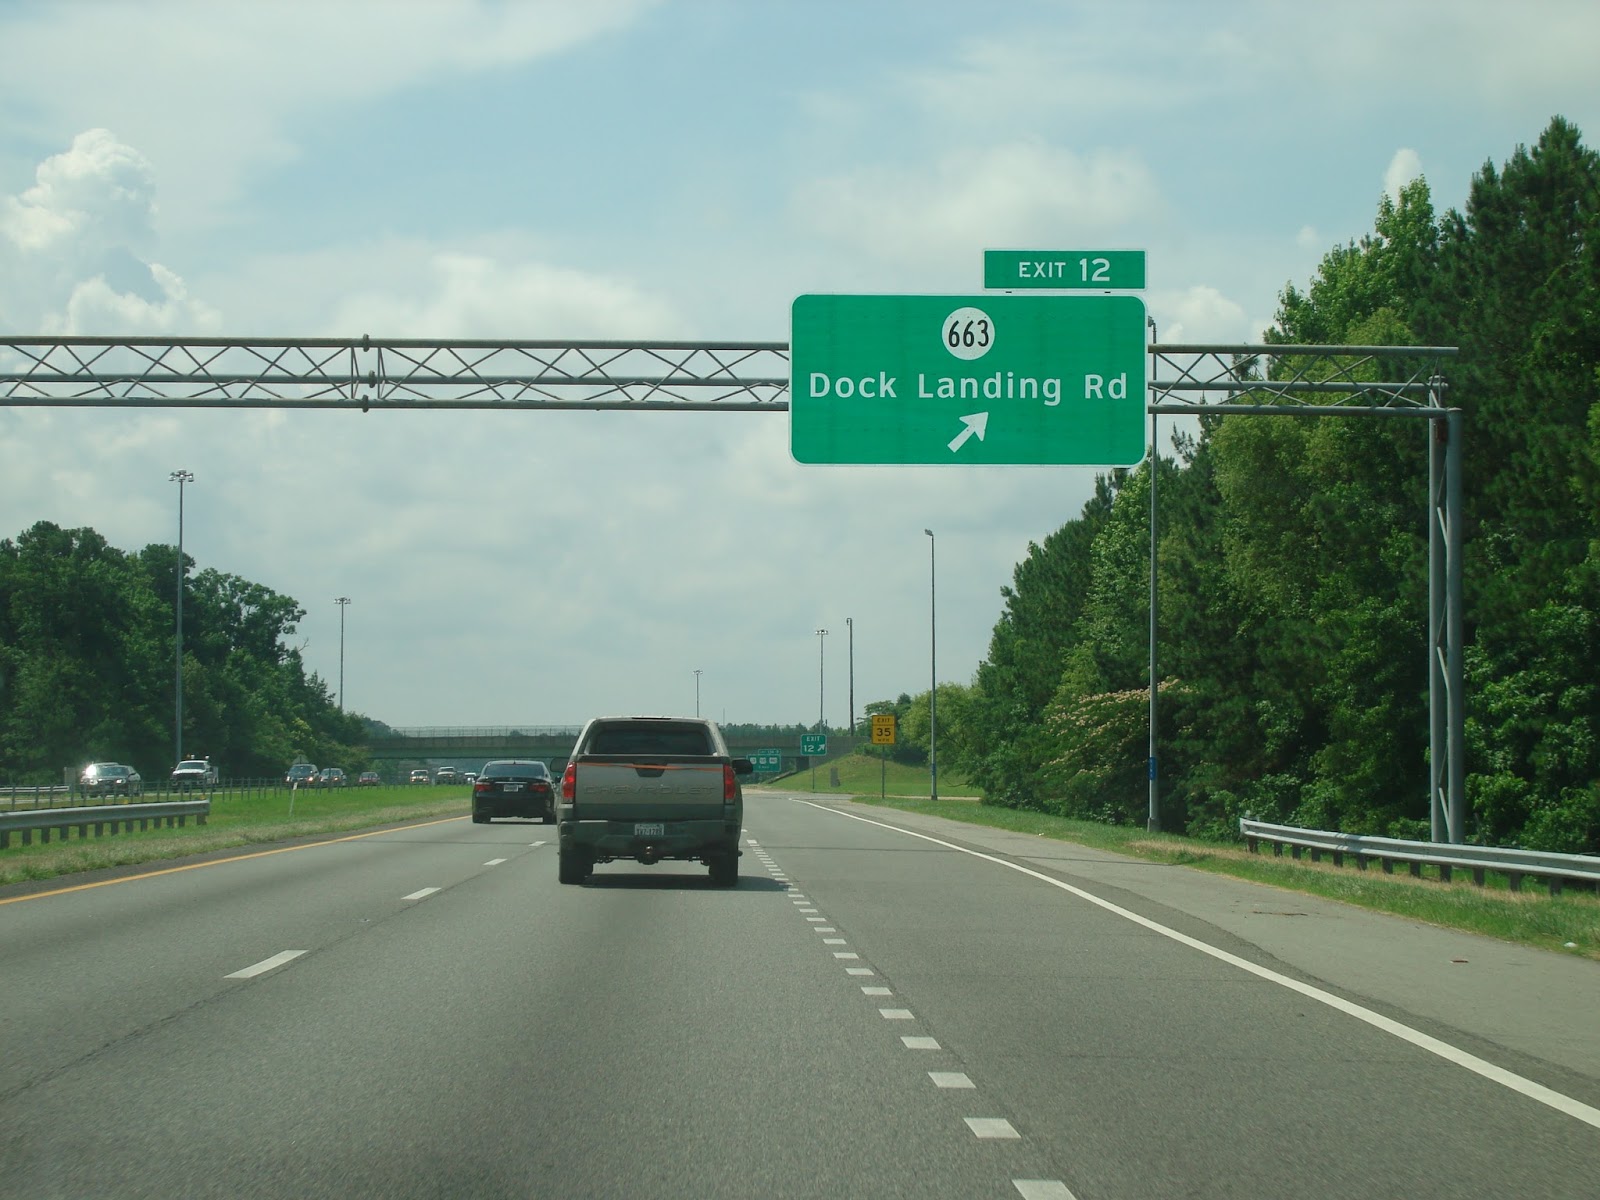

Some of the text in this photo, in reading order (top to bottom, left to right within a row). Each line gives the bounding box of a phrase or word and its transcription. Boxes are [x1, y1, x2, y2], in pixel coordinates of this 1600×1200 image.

[1018, 258, 1111, 282] EXIT 12
[948, 319, 990, 348] 663
[809, 371, 1128, 406] Dock Landing Rd
[876, 727, 891, 737] 35
[803, 744, 814, 752] 12
[584, 786, 716, 795] CHEVROLET
